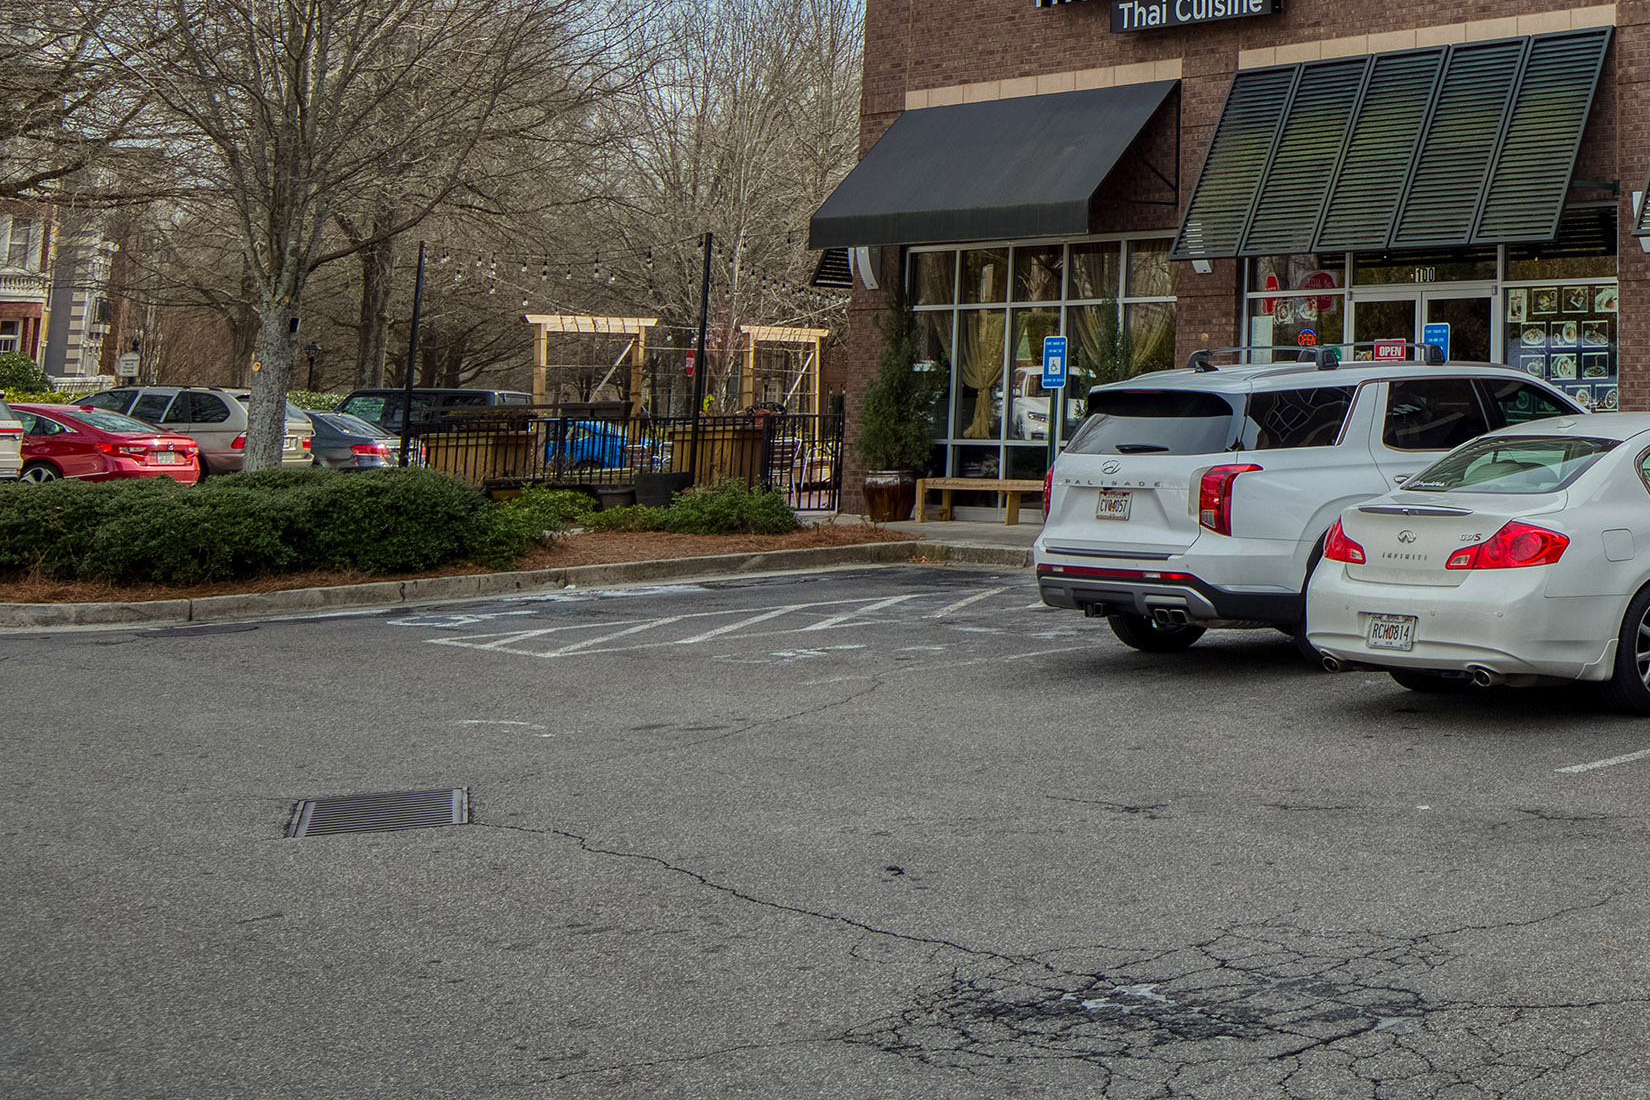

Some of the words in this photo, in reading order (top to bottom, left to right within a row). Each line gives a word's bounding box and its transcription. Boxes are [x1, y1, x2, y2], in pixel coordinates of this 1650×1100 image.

[1415, 267, 1435, 283] 100
[1379, 346, 1402, 357] OPEN
[1065, 479, 1161, 488] PALISADE
[1382, 551, 1428, 561] INFINITI
[1371, 622, 1411, 642] RCH0814
